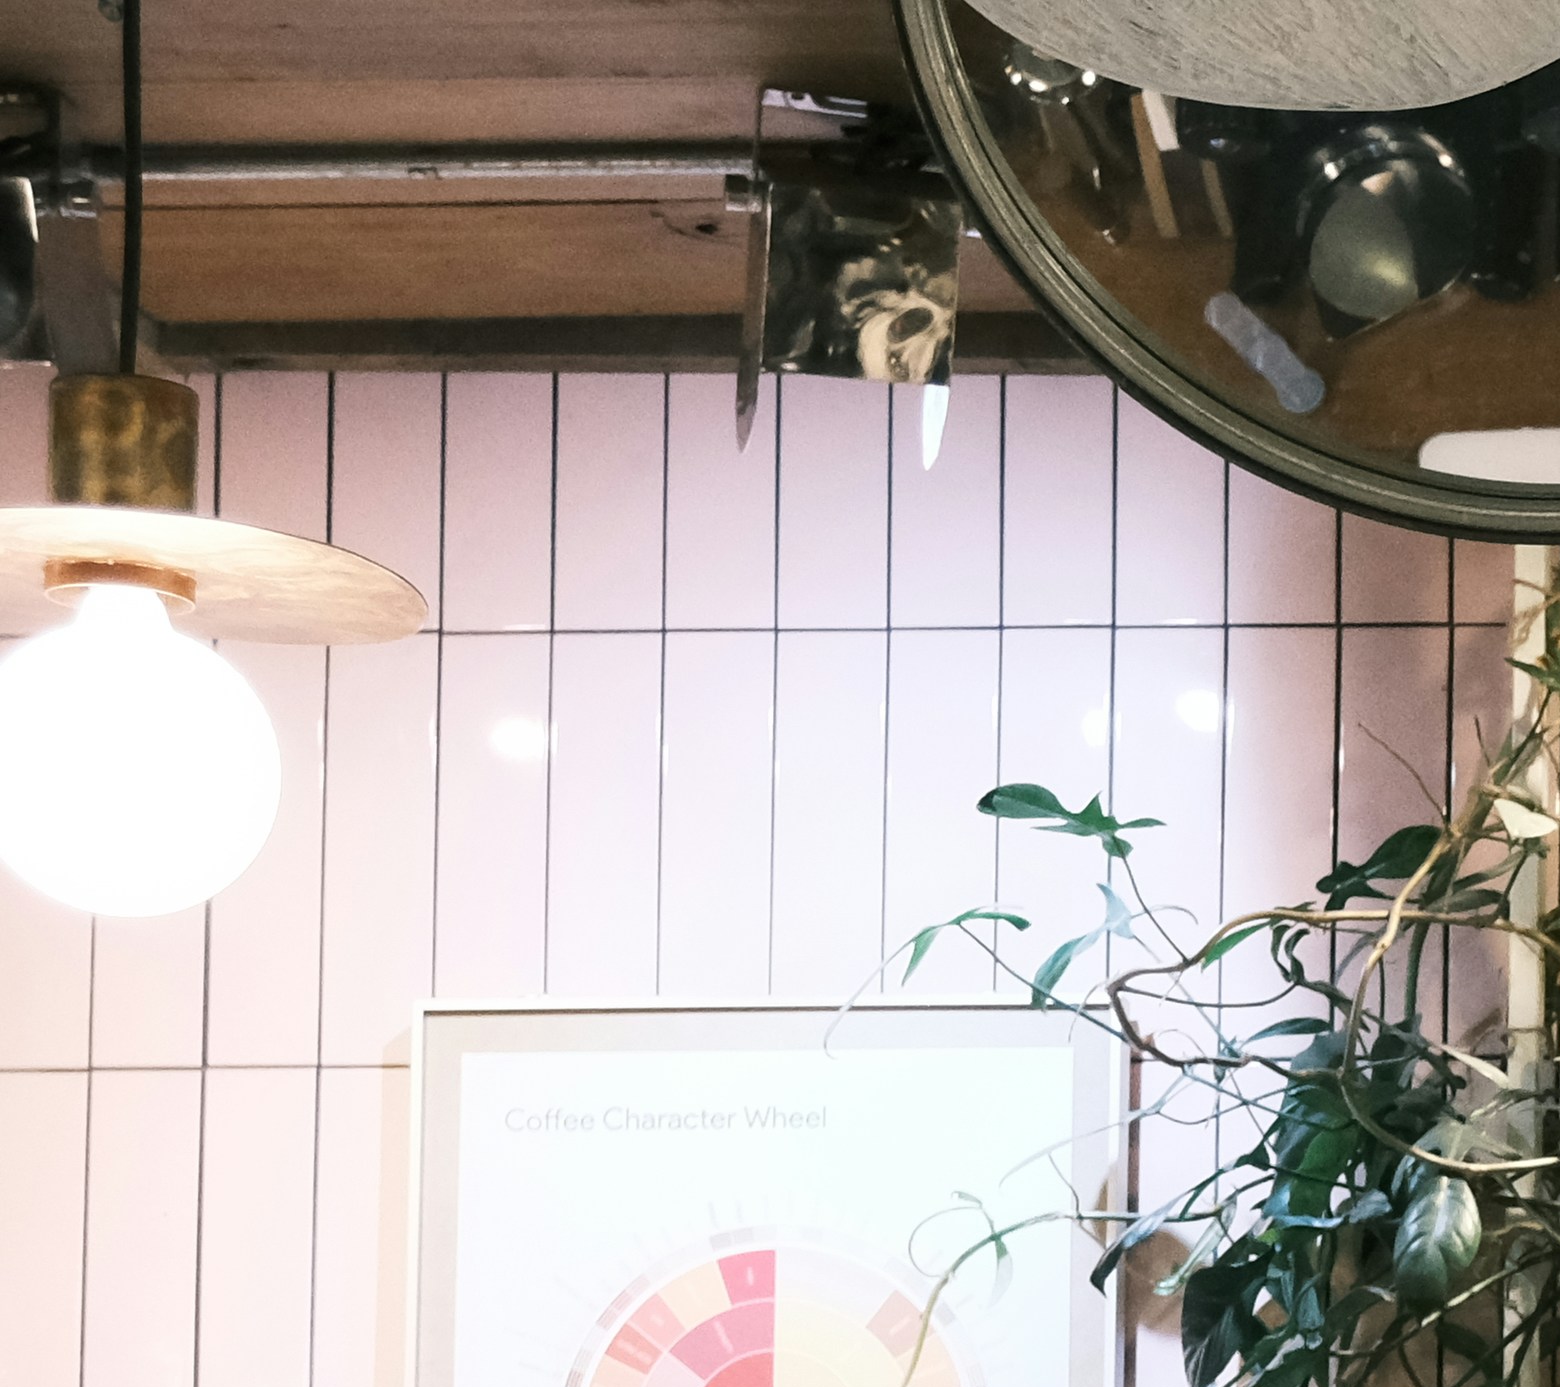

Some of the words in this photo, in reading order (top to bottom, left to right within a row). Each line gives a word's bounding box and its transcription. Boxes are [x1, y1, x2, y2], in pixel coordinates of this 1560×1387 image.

[504, 1107, 595, 1132] Coffee
[602, 1105, 738, 1131] Character
[743, 1104, 828, 1129] Wheel
